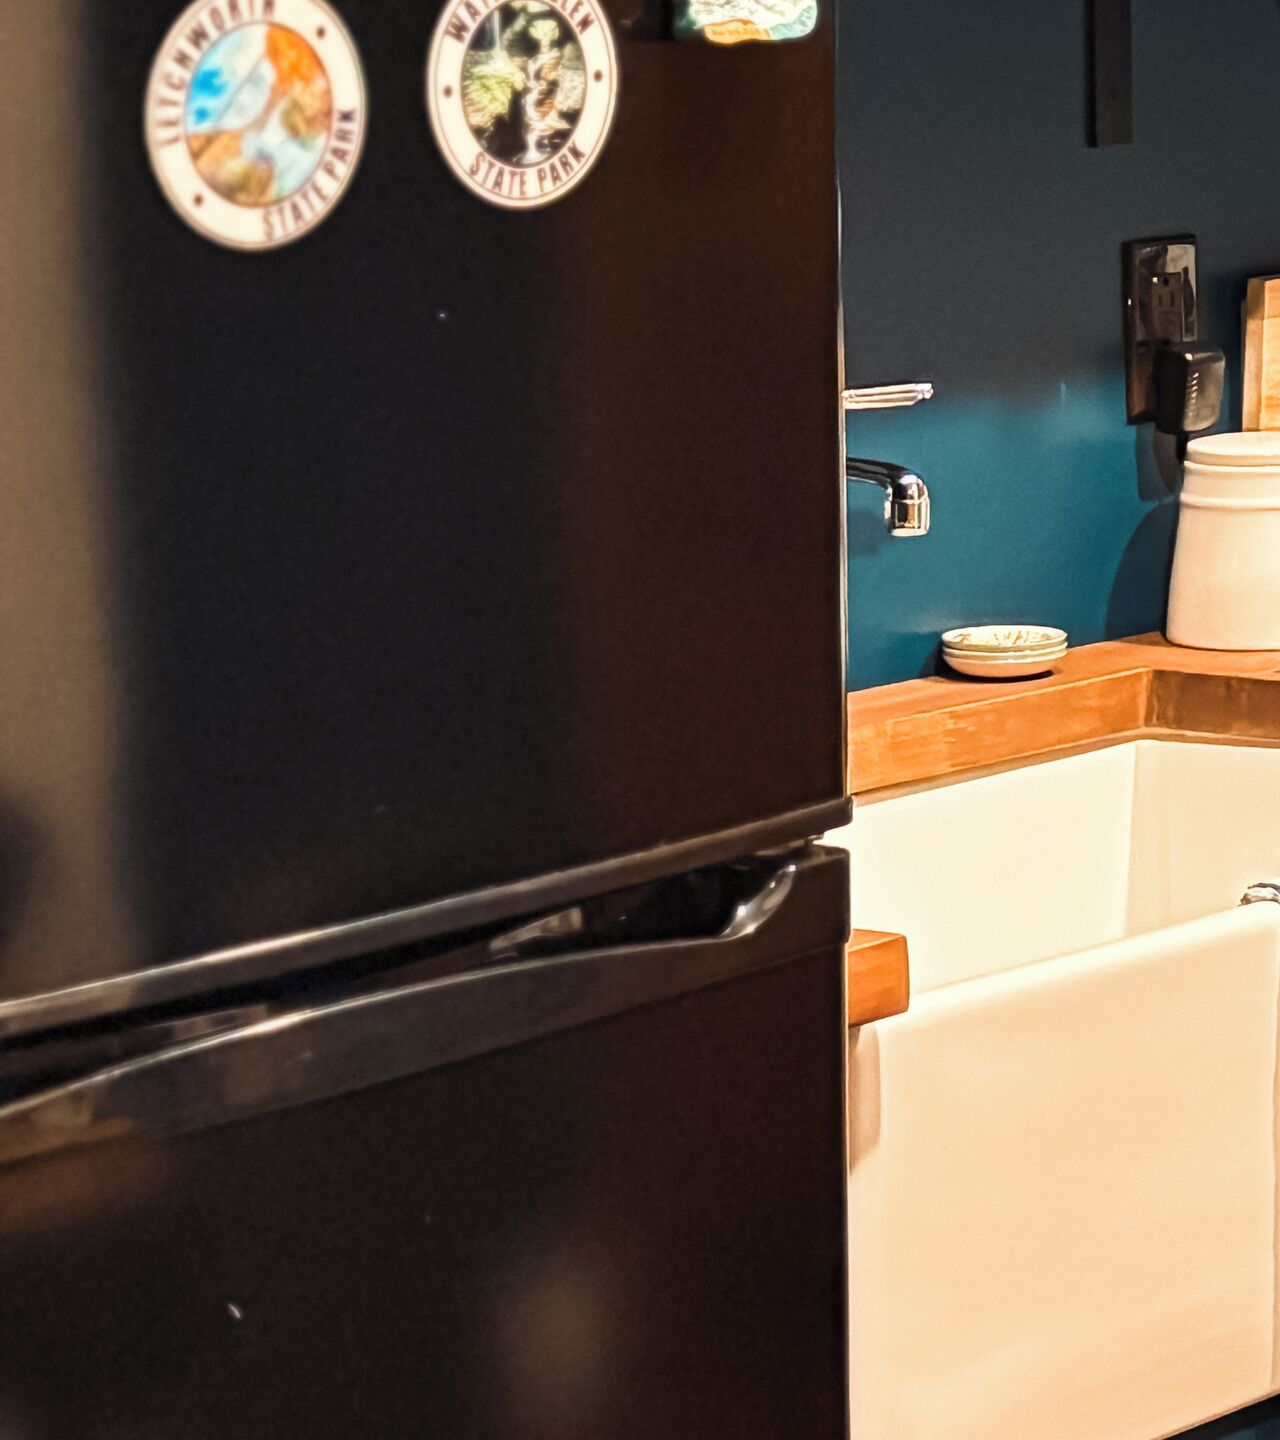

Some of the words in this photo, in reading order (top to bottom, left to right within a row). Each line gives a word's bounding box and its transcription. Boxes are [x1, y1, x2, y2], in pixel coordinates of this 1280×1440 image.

[262, 185, 331, 241] STATE
[325, 108, 357, 182] PARK
[469, 151, 528, 197] STATE
[537, 141, 587, 193] PARK
